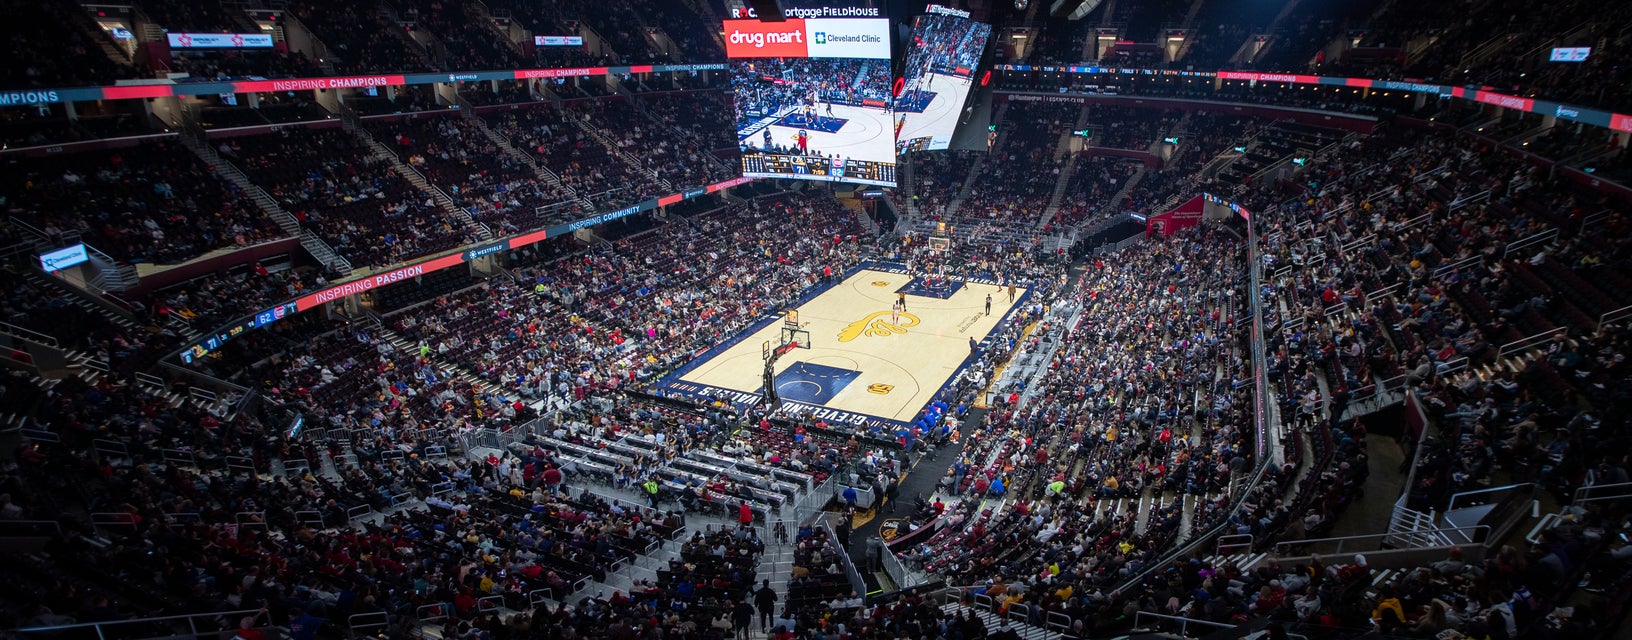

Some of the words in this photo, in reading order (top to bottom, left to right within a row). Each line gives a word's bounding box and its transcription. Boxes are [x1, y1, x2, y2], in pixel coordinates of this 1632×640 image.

[785, 7, 822, 19] ortgage
[730, 30, 764, 47] drug
[767, 30, 802, 43] mart
[827, 34, 860, 43] Cleveland
[861, 35, 881, 43] Clinic
[525, 70, 554, 78] INSPIRING
[1260, 74, 1296, 82] CHAMPIONS
[274, 80, 326, 90] INSPIRING
[330, 77, 387, 87] CHAMPIONS
[797, 166, 805, 174] 71
[832, 168, 842, 176] 62
[569, 216, 601, 231] INSPIRING
[603, 205, 640, 221] COMMUNITY
[477, 245, 502, 256] WESTFIELD
[315, 279, 372, 304] INSPIRING
[376, 265, 423, 285] PASSION
[207, 338, 217, 349] 71
[260, 313, 271, 324] 62
